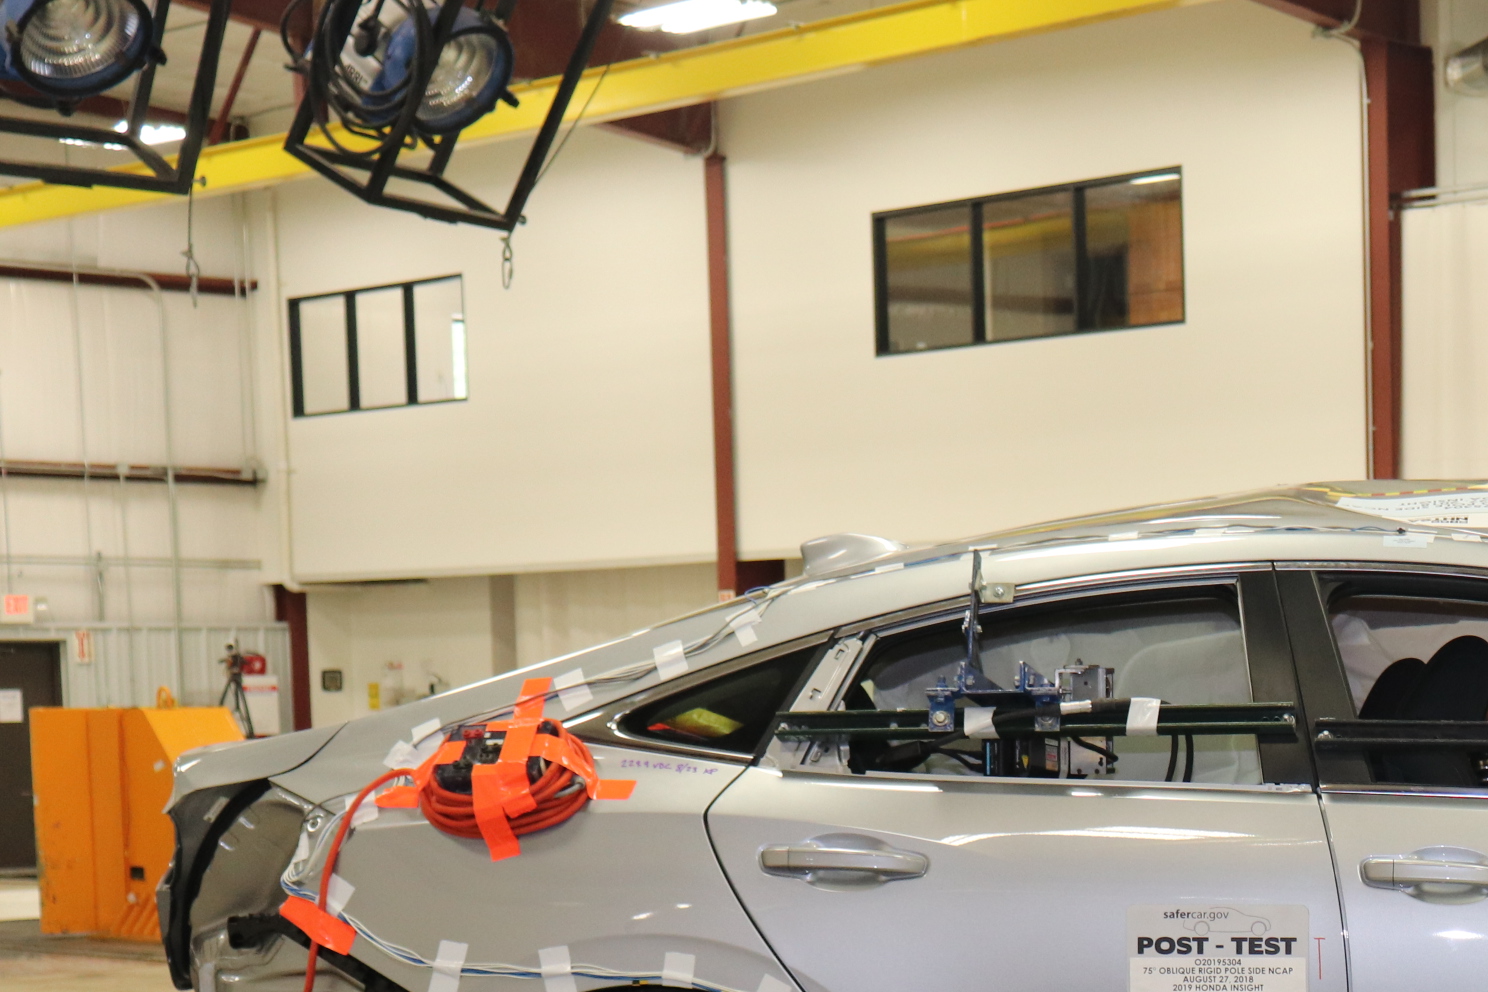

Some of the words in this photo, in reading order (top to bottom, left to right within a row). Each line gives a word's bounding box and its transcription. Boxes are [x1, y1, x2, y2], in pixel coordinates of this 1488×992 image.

[1163, 909, 1229, 921] safercar.gov
[1137, 936, 1209, 955] POST
[1231, 936, 1297, 955] TEST
[1143, 967, 1156, 975] 75°
[1158, 967, 1196, 975] OBLIQUE
[1198, 967, 1222, 975] RIGID
[1224, 967, 1245, 975] POLE
[1247, 967, 1266, 975] SIDE
[1268, 967, 1293, 975] NCAP
[1182, 975, 1217, 983] AUGUST
[1218, 975, 1231, 984] 27,
[1233, 975, 1254, 983] 2018
[1172, 984, 1193, 992] 2019
[1195, 984, 1228, 992] HONDA
[1230, 984, 1264, 992] INSIGHT
